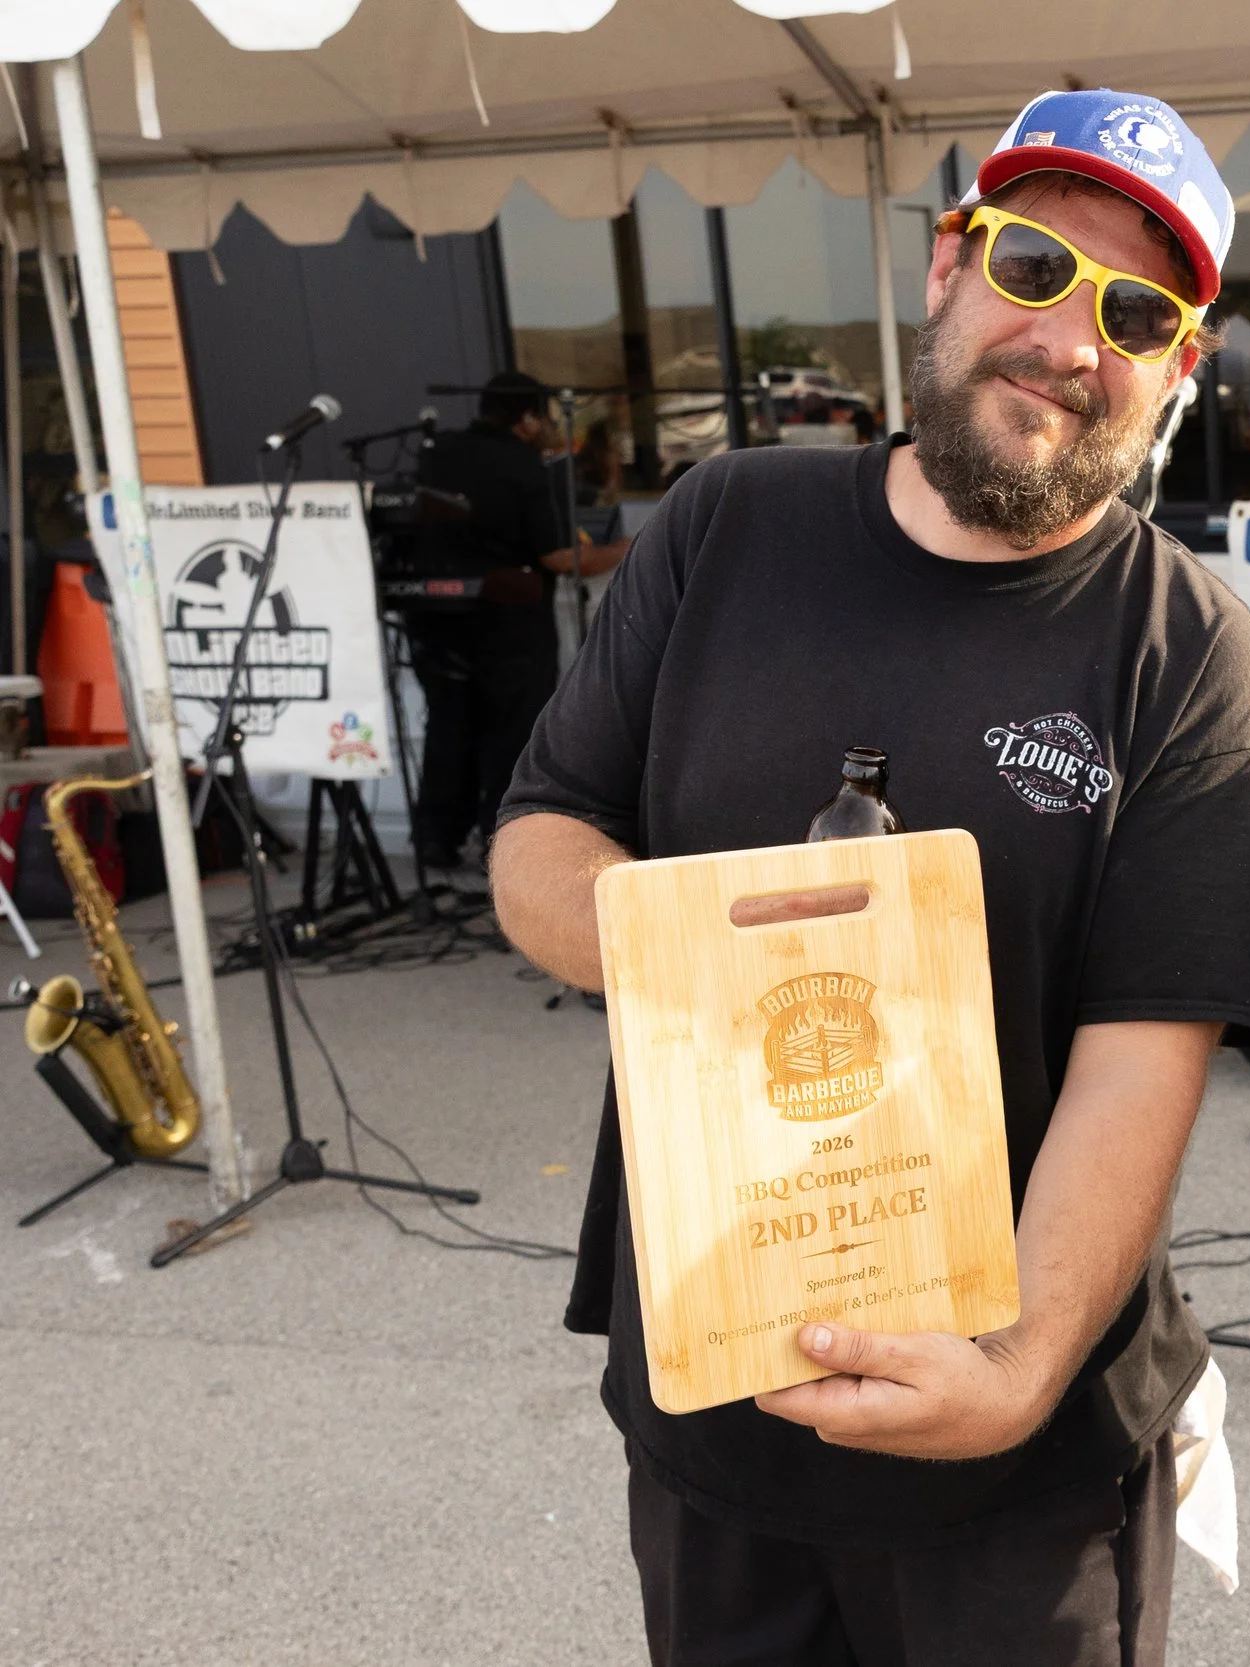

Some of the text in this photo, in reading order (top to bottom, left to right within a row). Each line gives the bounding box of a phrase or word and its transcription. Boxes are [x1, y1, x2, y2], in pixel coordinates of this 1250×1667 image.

[1104, 104, 1141, 120] WHAS
[1097, 129, 1117, 150] FOR
[244, 501, 295, 520] Shw
[1033, 718, 1094, 751] HOT CHICKEN
[984, 727, 1113, 803] LOUIE'S
[1022, 787, 1069, 808] BARBECUE
[762, 976, 872, 1016] BOURBON
[772, 1067, 882, 1103] BARBECUE
[786, 1092, 871, 1118] AND MAYHEM
[811, 1134, 854, 1155] 2026
[734, 1152, 932, 1206] BBQ Competition
[749, 1187, 928, 1250] 2ND PLACE
[806, 1264, 886, 1293] Sponsored By:
[708, 1319, 776, 1345] Operation
[779, 1308, 809, 1327] BBQ
[851, 1296, 862, 1309] &
[865, 1286, 904, 1306] Chef's
[907, 1281, 929, 1296] Cut
